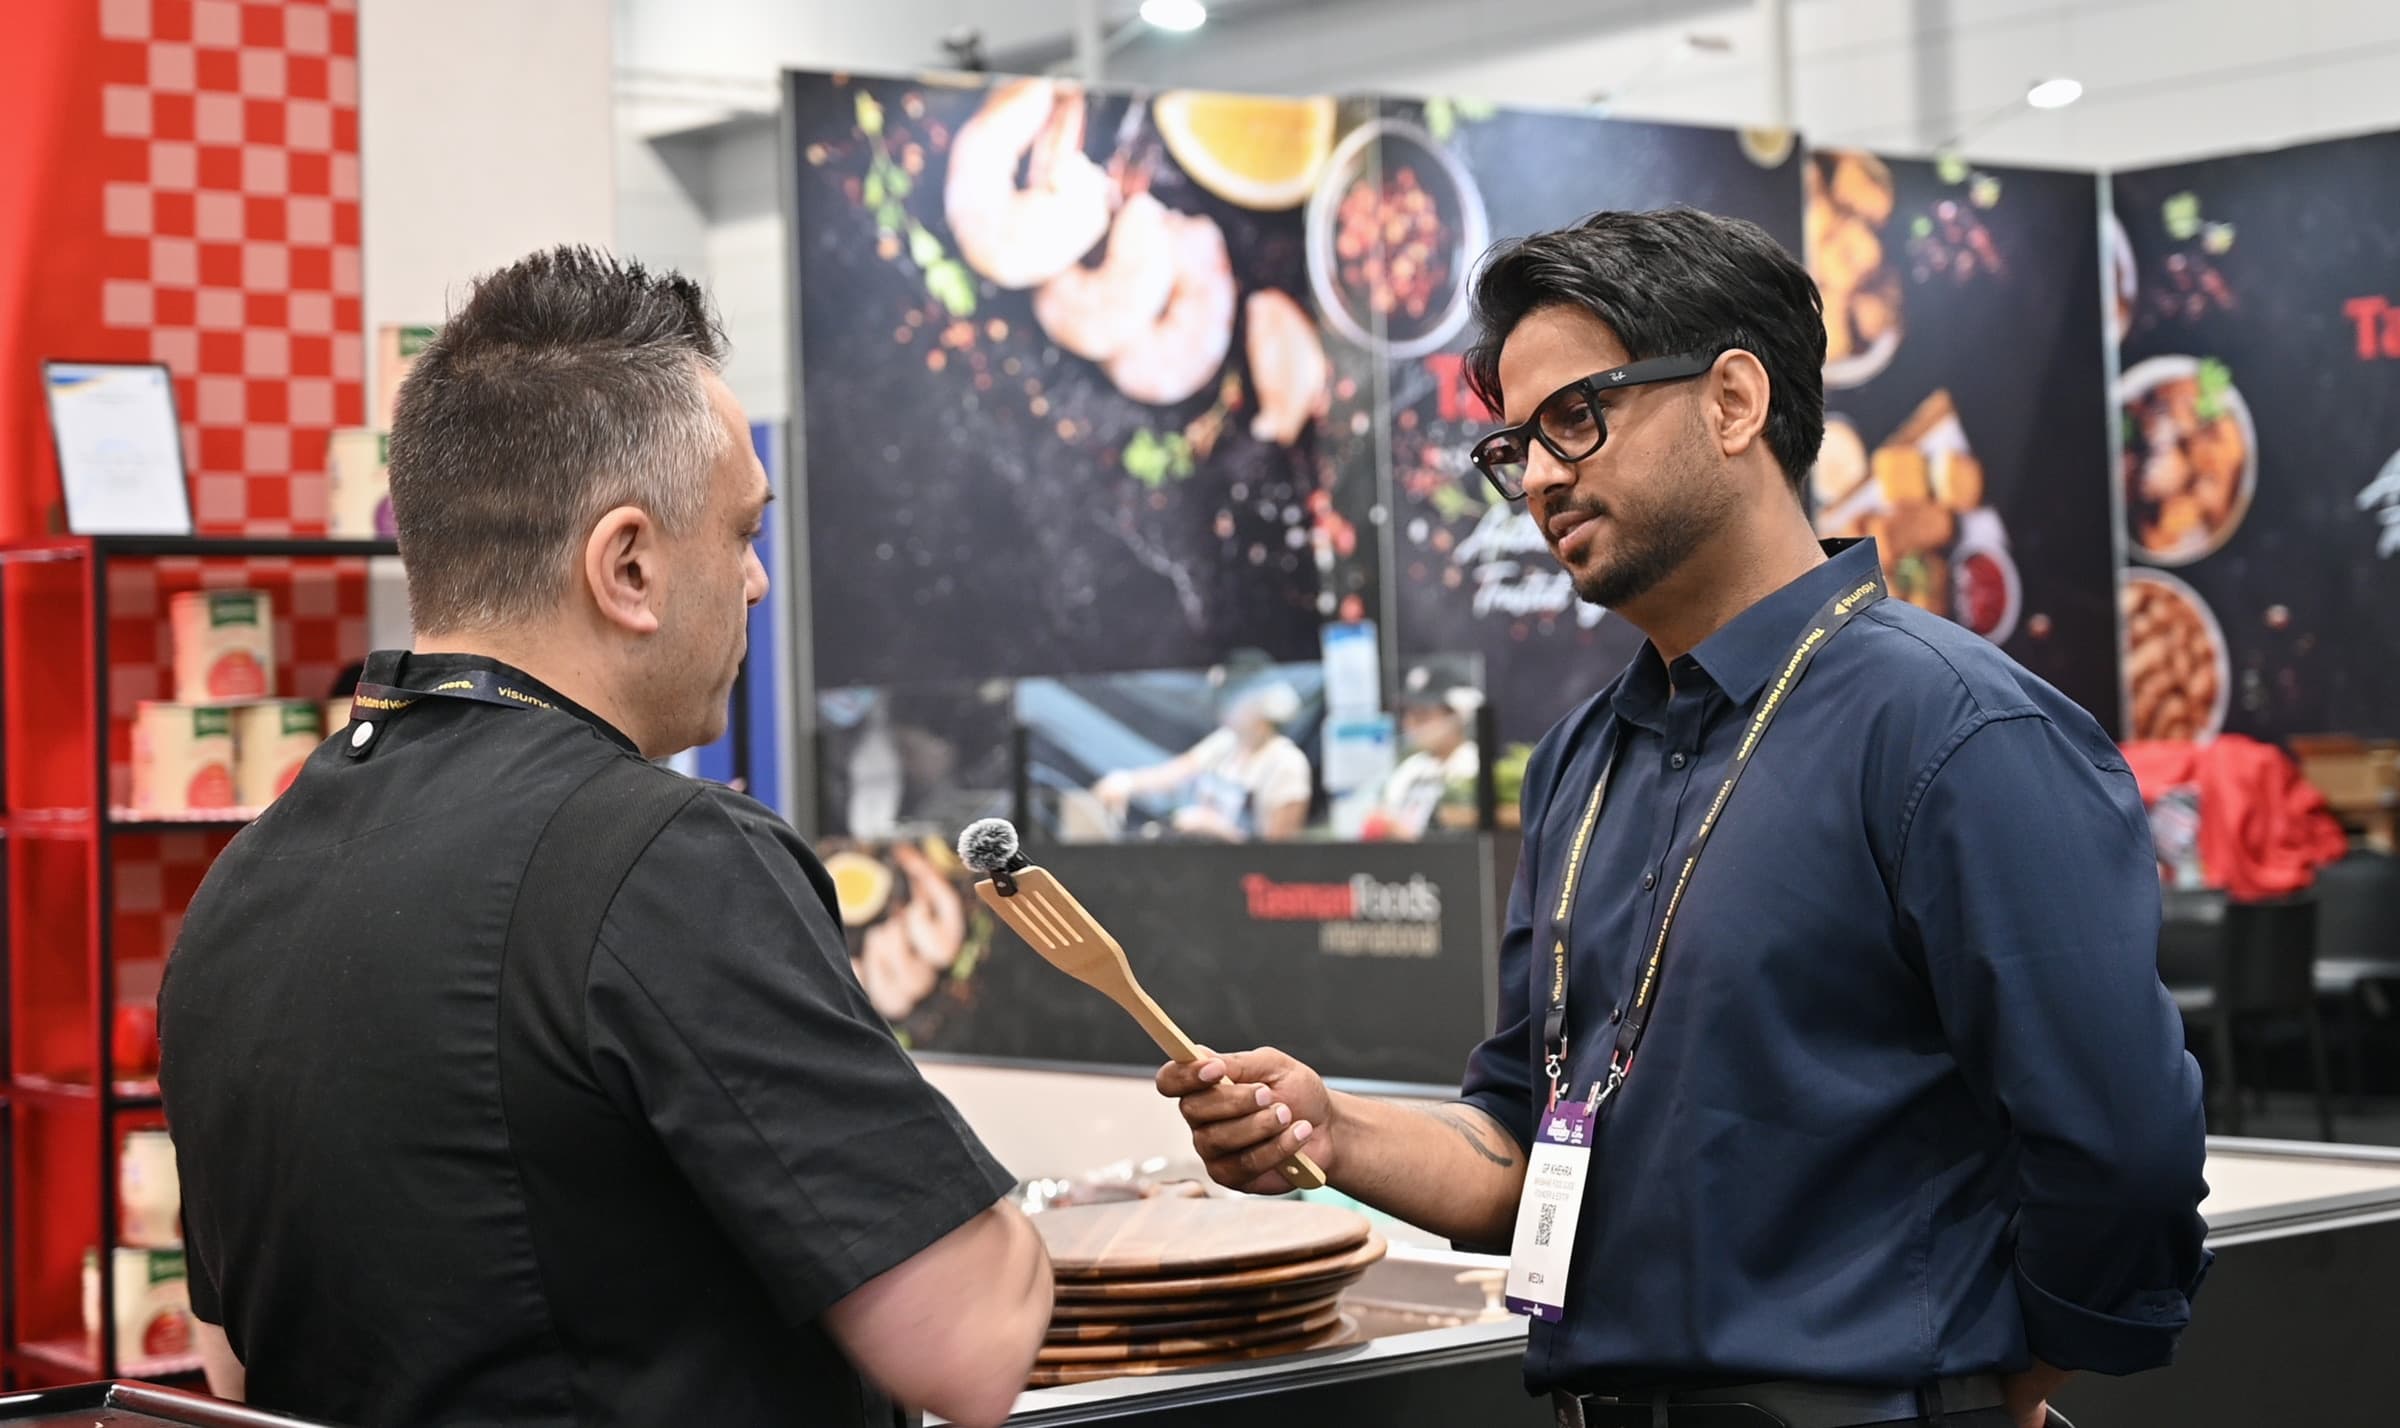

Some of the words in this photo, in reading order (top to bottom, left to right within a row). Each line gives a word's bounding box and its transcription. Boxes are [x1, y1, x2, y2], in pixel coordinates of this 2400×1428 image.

[1842, 581, 1878, 608] visumé
[1806, 627, 1825, 644] The
[1784, 643, 1810, 678] Future
[1776, 677, 1788, 691] of
[1756, 689, 1781, 722] Hiring
